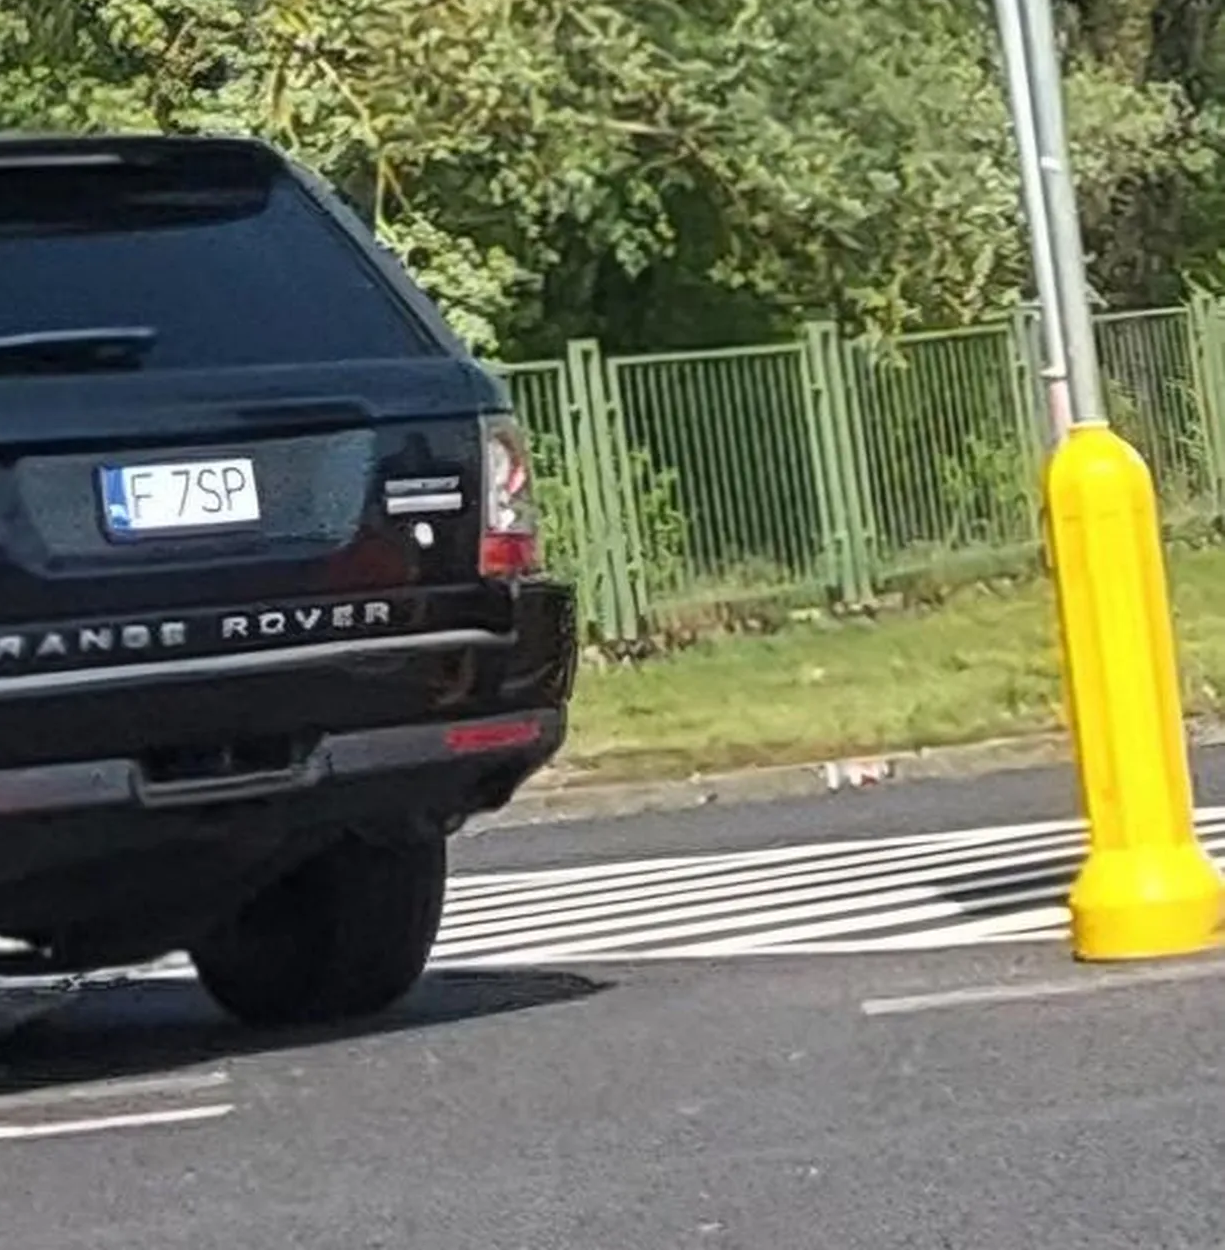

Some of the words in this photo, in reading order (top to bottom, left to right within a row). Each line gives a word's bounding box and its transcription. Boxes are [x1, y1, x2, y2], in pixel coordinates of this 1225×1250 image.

[131, 472, 154, 519] F
[171, 466, 247, 518] 7SP
[221, 600, 391, 639] ROVER
